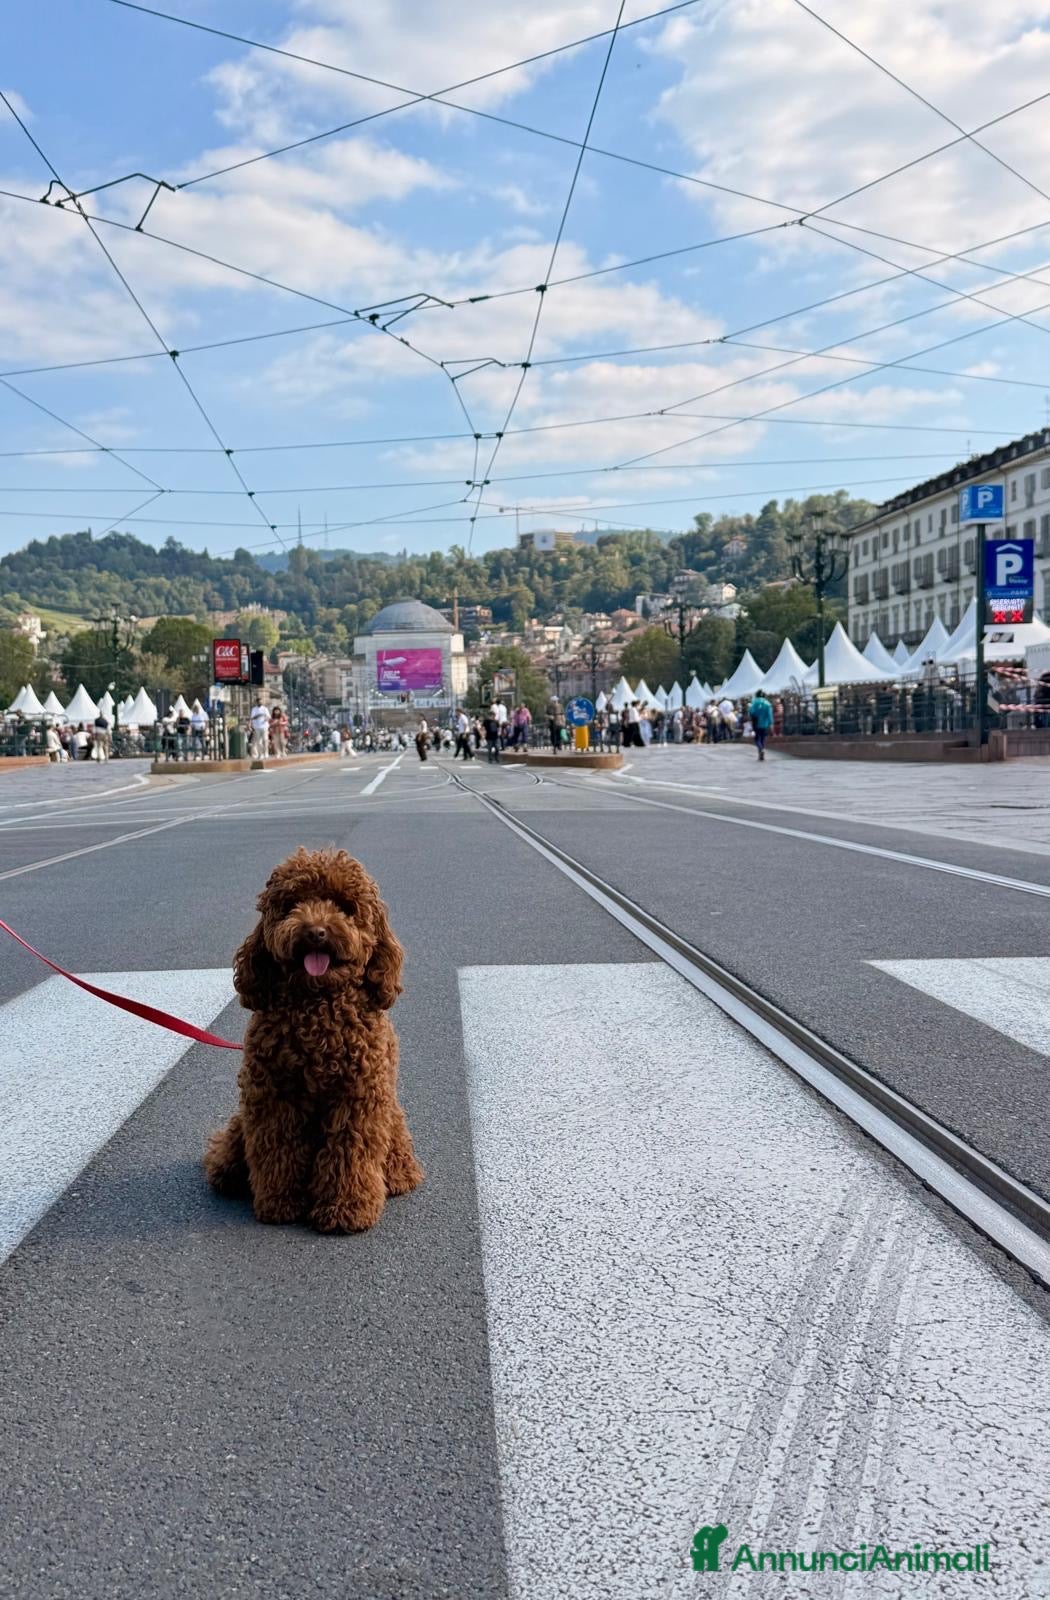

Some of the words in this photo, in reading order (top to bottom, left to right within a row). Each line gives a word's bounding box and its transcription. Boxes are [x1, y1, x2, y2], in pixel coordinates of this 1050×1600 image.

[978, 491, 993, 509] P
[997, 553, 1023, 586] P
[215, 646, 239, 657] C&C
